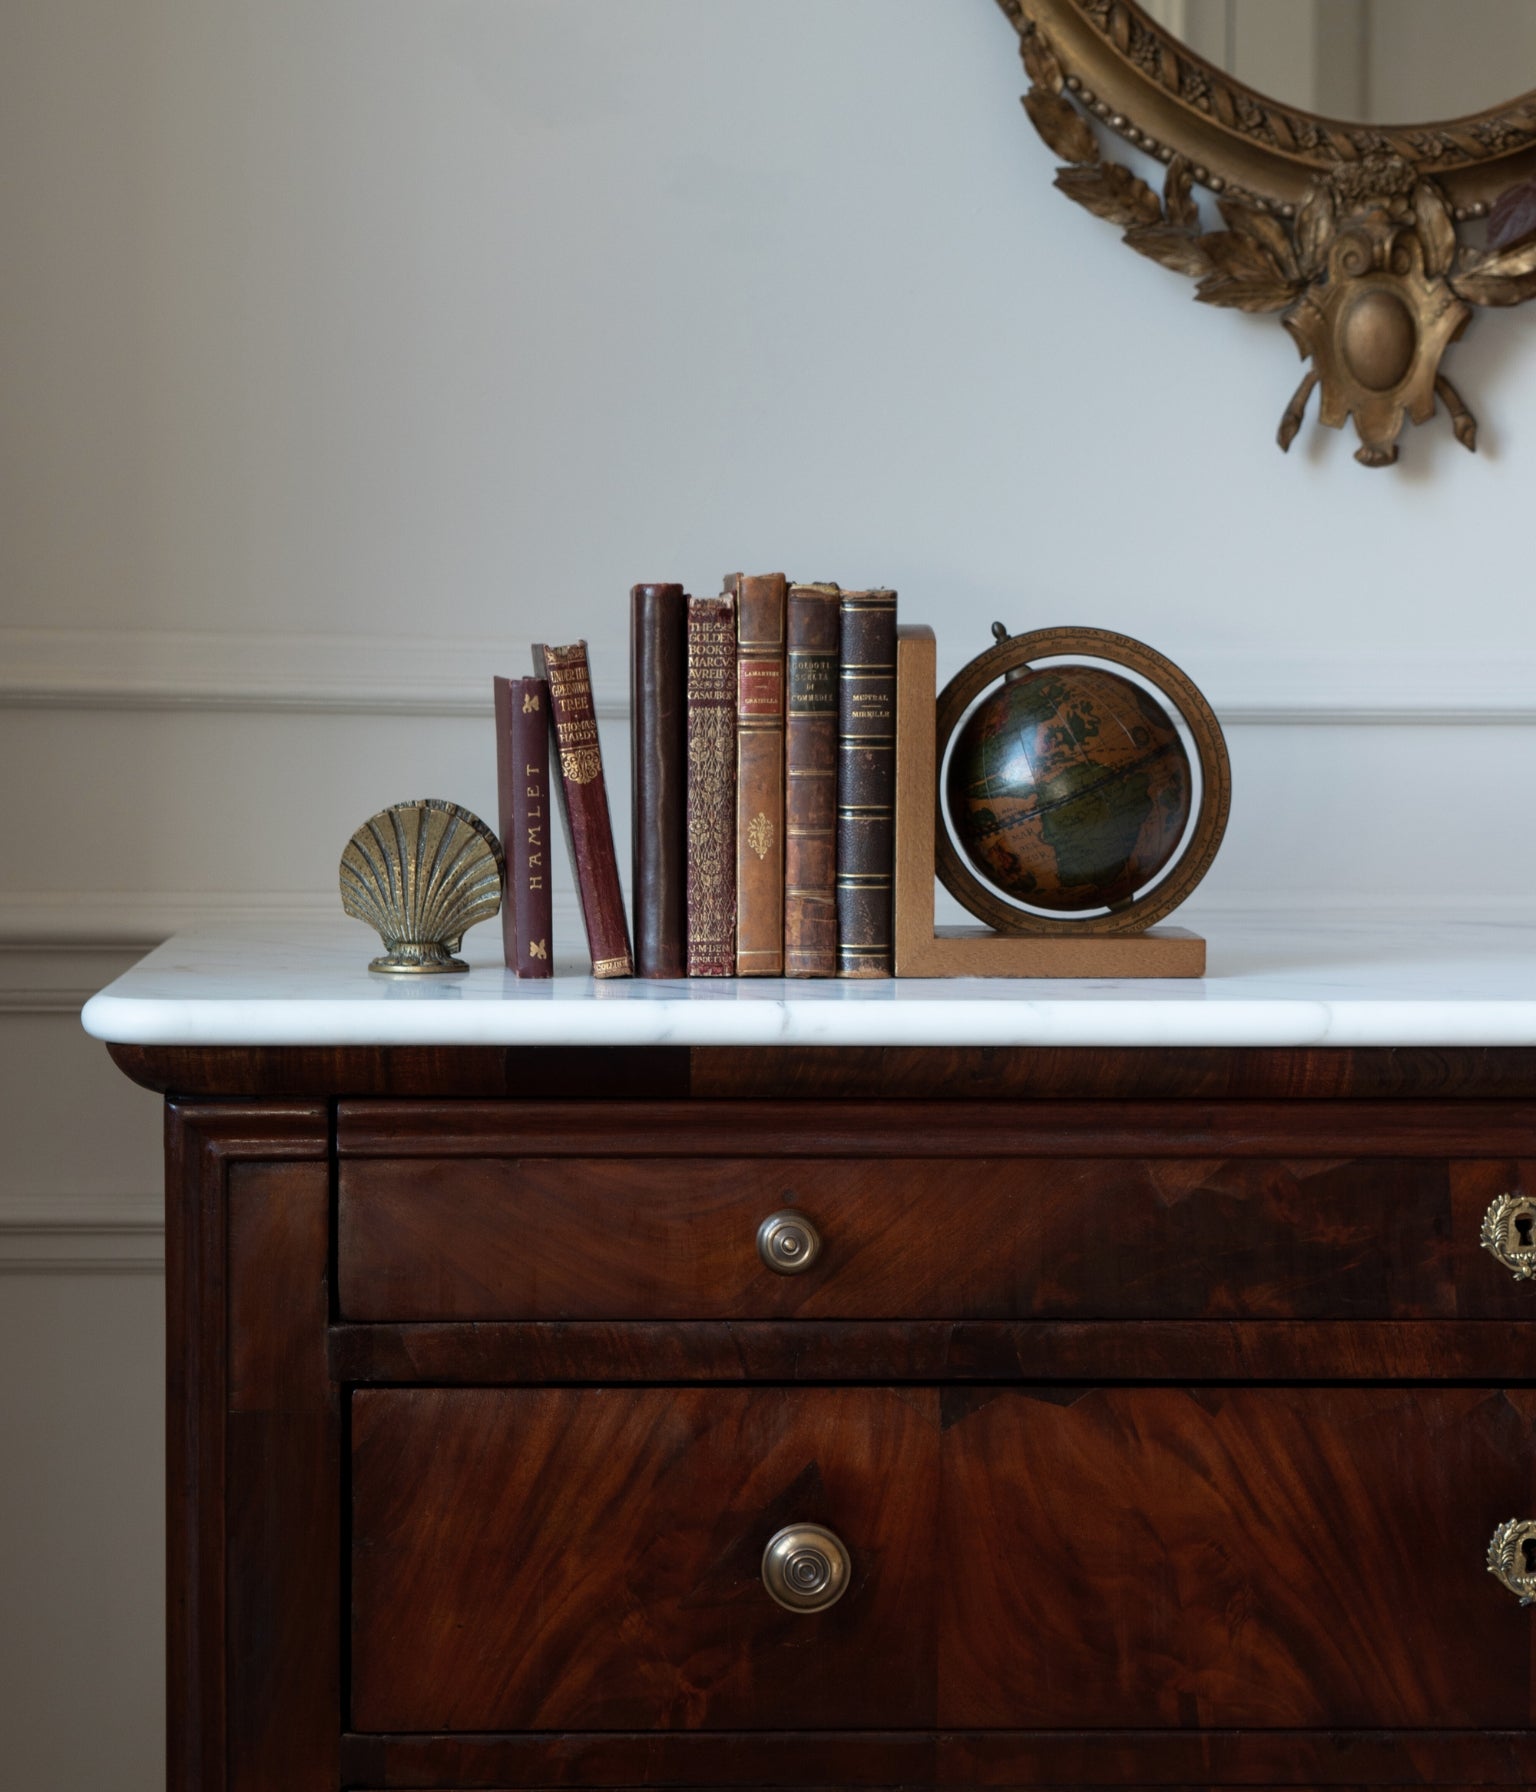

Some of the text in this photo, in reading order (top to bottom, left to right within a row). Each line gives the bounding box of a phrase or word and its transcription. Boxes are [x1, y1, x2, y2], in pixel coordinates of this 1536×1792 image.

[689, 622, 713, 632] THE
[688, 633, 736, 643] GOLDEN
[688, 644, 724, 655] BOOK
[688, 657, 736, 668] MARCVS
[557, 719, 596, 733] THOMAS
[559, 729, 597, 743] HARDY
[526, 764, 542, 890] HAMLET
